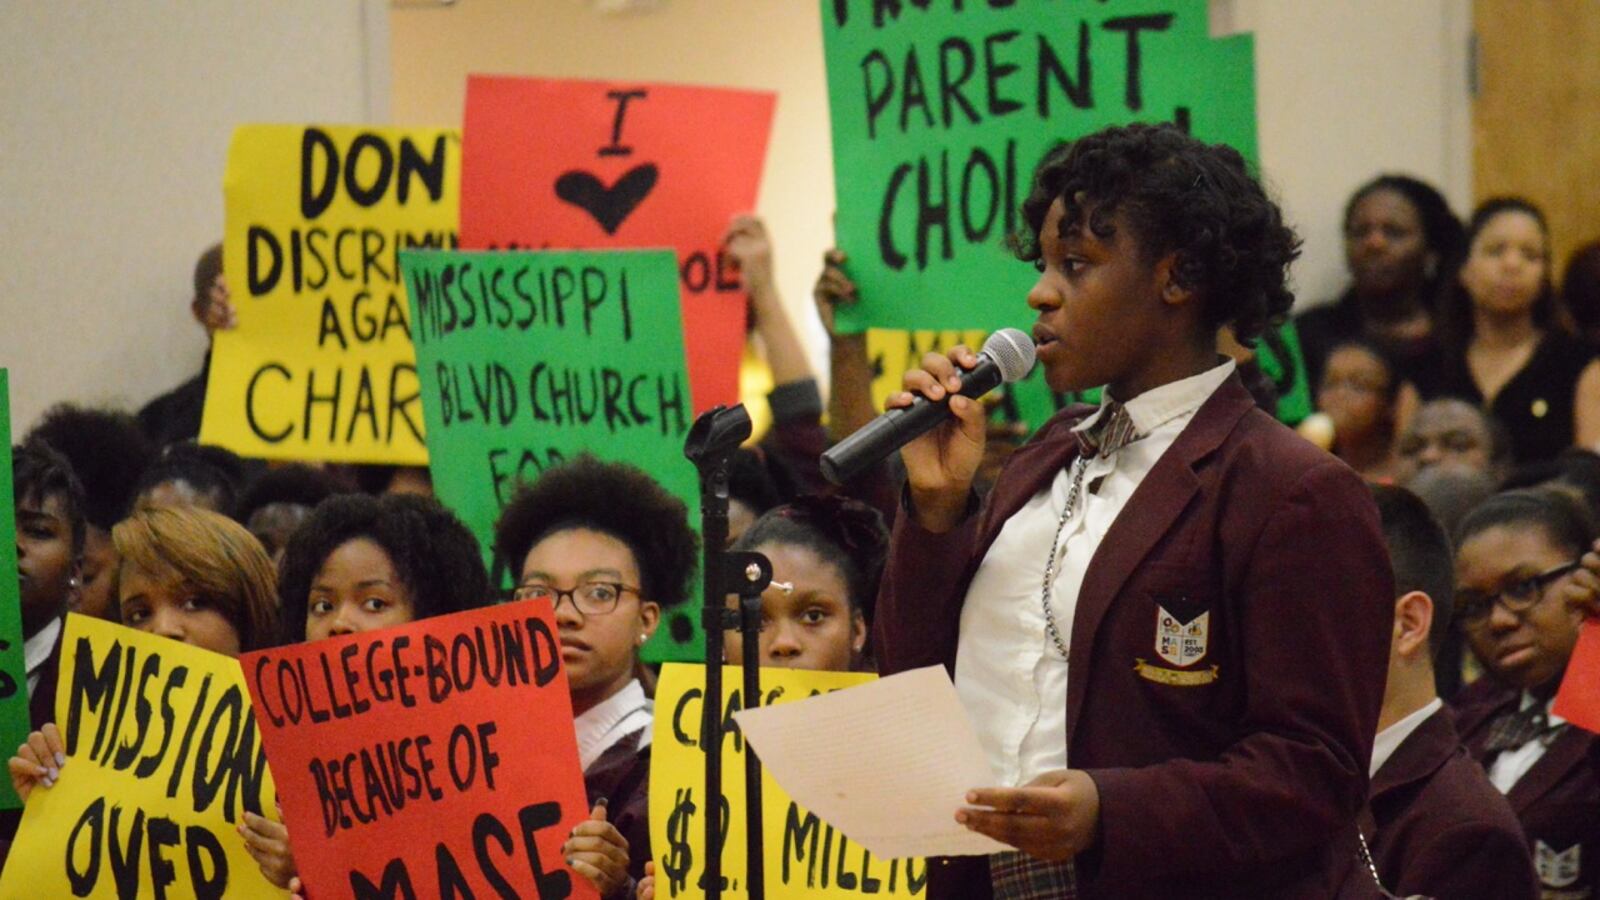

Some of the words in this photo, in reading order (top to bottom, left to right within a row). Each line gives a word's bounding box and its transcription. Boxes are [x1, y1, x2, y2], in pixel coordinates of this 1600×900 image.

[596, 89, 648, 157] I
[861, 13, 1175, 139] PARENT
[877, 138, 1060, 272] CHOI
[411, 262, 633, 344] MISSISSIPPI
[435, 360, 518, 428] BLVD
[529, 362, 687, 437] CHURCH
[255, 617, 560, 728] COLLEGE-BOUND
[65, 637, 268, 825] MISSION
[308, 735, 443, 839] BECAUSE
[448, 721, 500, 792] OF
